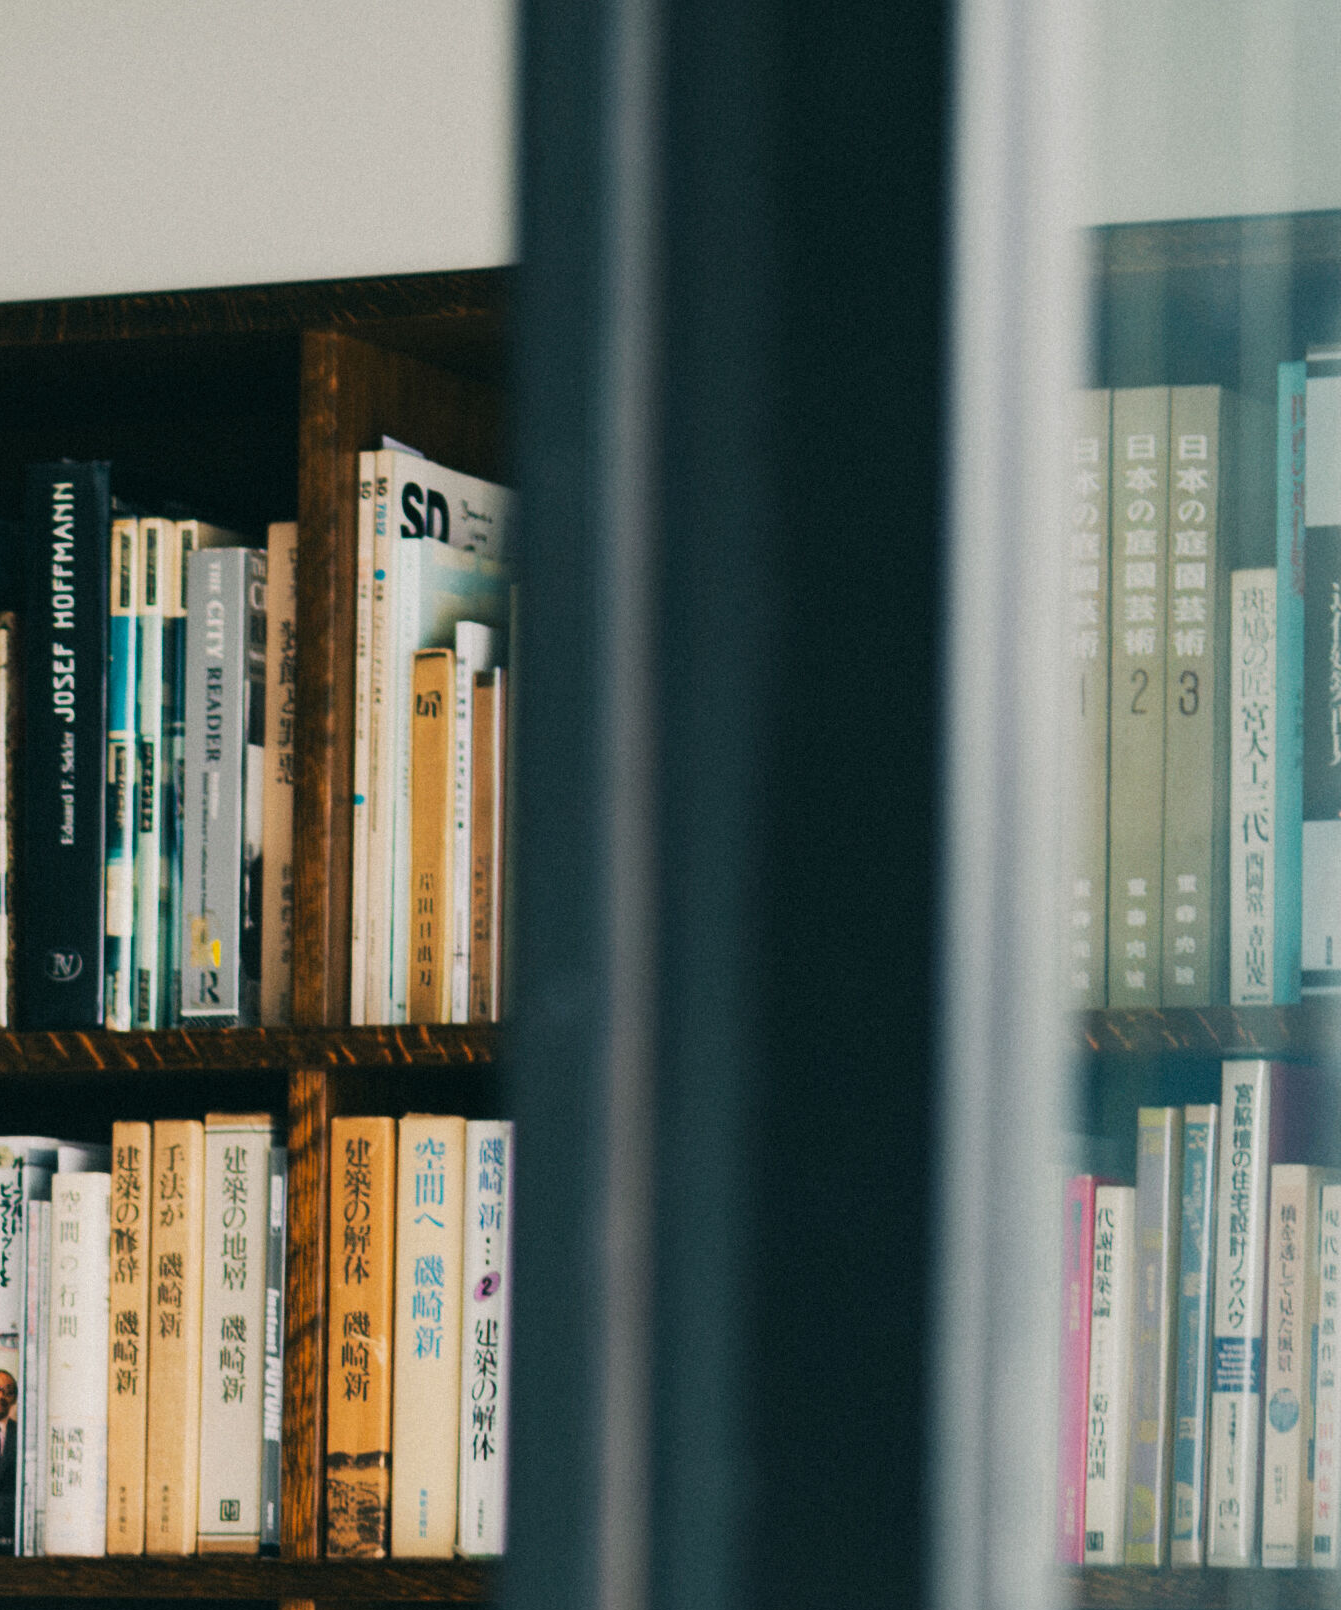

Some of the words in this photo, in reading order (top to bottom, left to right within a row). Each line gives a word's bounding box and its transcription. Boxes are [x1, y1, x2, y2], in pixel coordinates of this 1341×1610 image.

[51, 482, 76, 627] HOFFMANN
[400, 481, 451, 543] SD
[1174, 434, 1209, 658] 日本の庭園芸術
[208, 561, 222, 594] THE
[204, 600, 225, 658] CITY
[52, 641, 75, 722] JOSEF
[203, 666, 222, 762] READER
[1130, 669, 1149, 714] 2
[1180, 671, 1200, 716] 3
[160, 1144, 185, 1226] 手法が
[221, 1146, 249, 1291] 建築の地層
[343, 1137, 371, 1285] 建築の解体
[414, 1137, 446, 1228] 空間へ
[158, 1253, 183, 1339] 磯崎新
[264, 1288, 279, 1352] Instant
[412, 1255, 445, 1360] 磯崎新
[480, 1276, 494, 1296] 2
[113, 1310, 139, 1395] 磯崎新
[219, 1314, 246, 1403] 磯崎新
[341, 1311, 371, 1402] 磯崎新
[471, 1319, 499, 1462] 建築の解体
[261, 1355, 282, 1441] FUTURE
